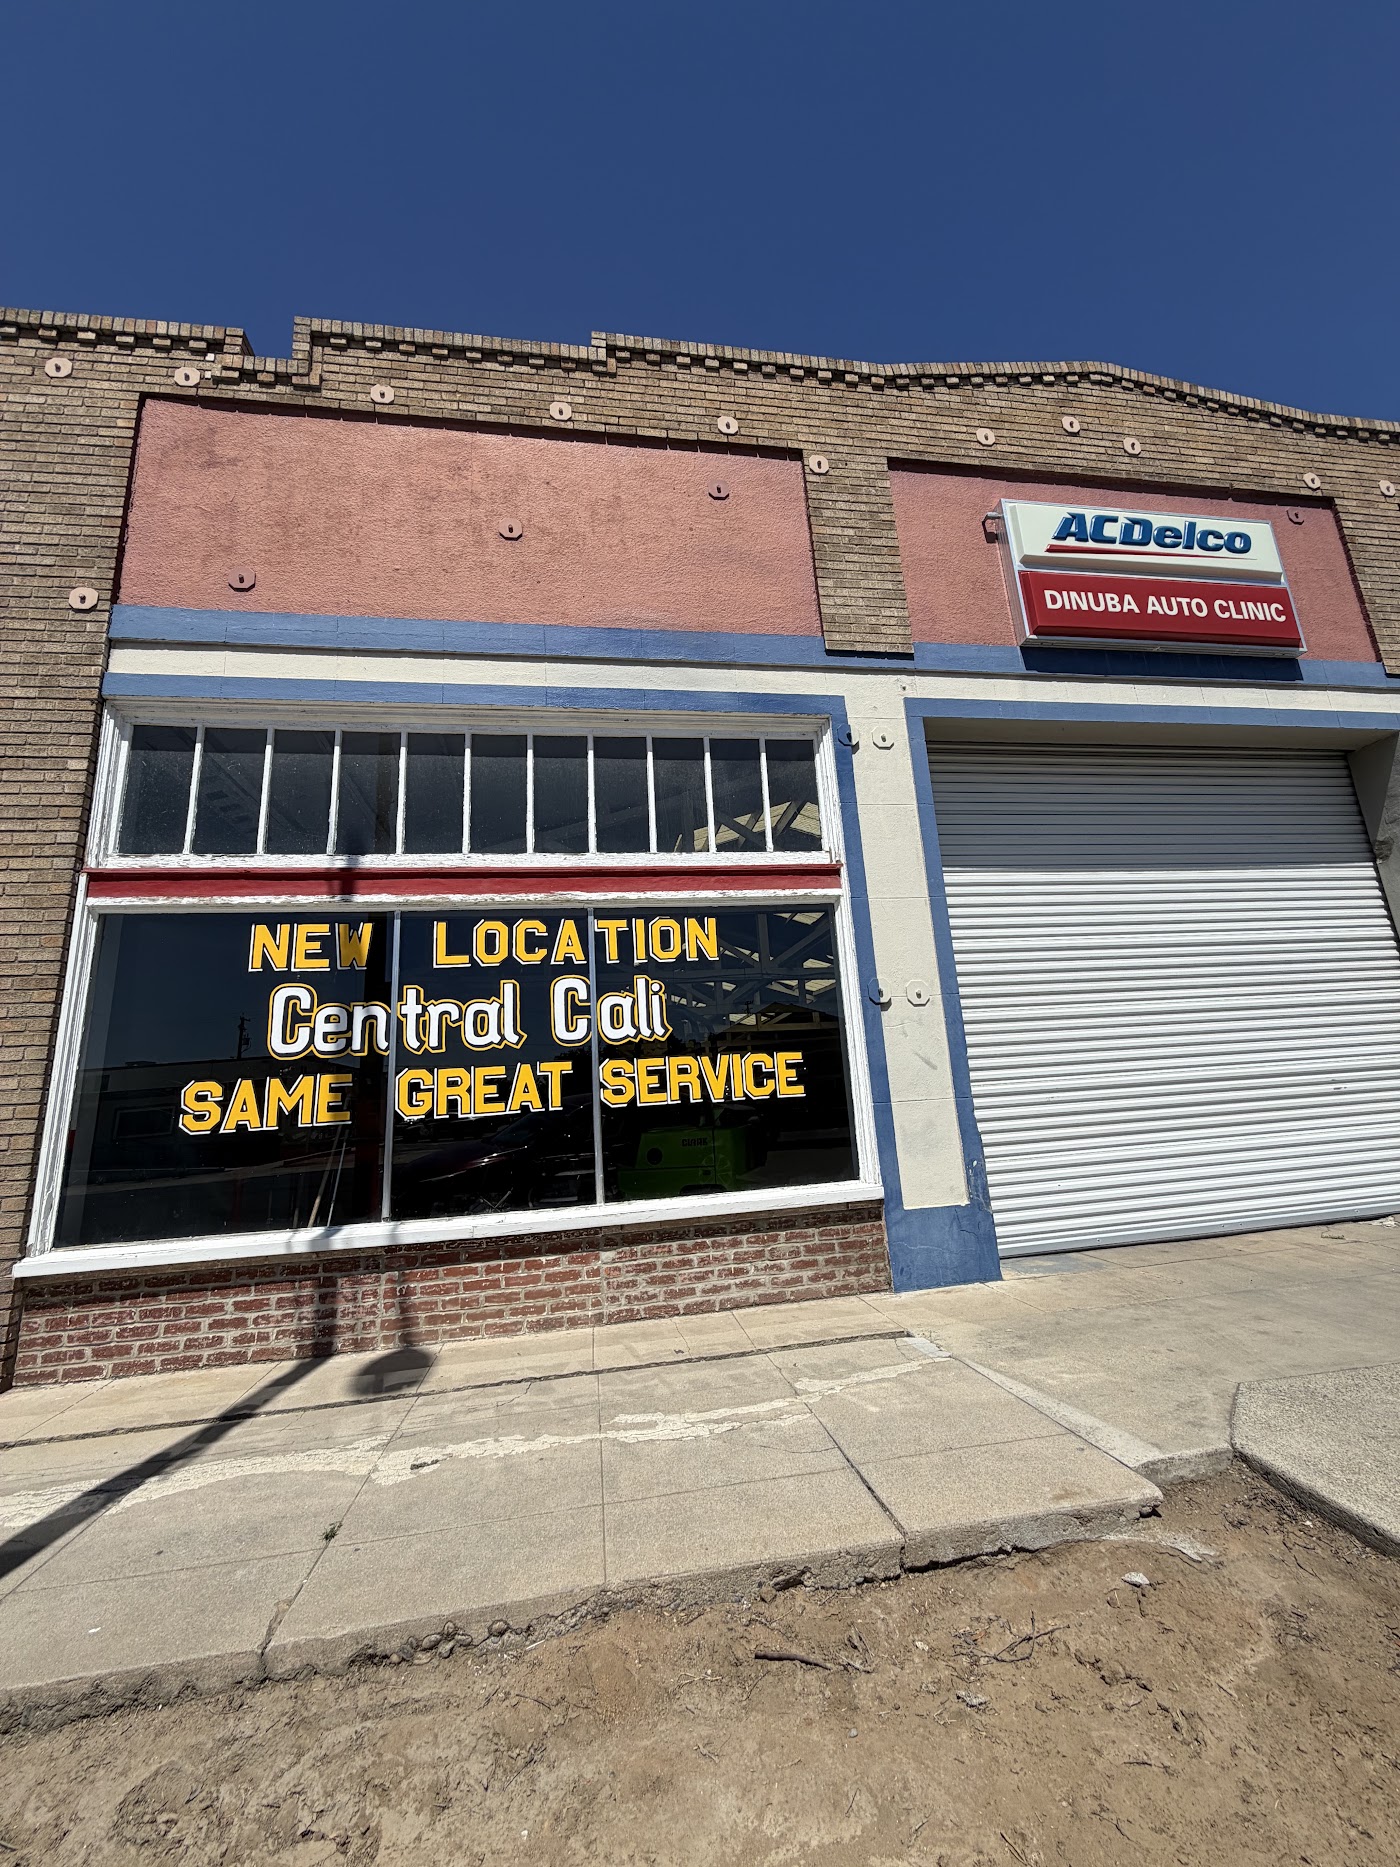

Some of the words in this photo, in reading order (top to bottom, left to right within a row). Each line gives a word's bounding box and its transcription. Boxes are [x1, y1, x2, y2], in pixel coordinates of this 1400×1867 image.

[1052, 512, 1252, 554] ACDelco
[1043, 589, 1140, 614] DINUBA
[1147, 595, 1208, 618] AUTO
[1214, 599, 1287, 622] CLINIC
[248, 922, 373, 972] NEW
[432, 917, 719, 968] LOCATION
[268, 979, 528, 1060] Central
[550, 973, 672, 1046] Cali
[178, 1073, 353, 1135] SAME
[395, 1061, 574, 1119] GREAT
[600, 1051, 807, 1107] SERVICE
